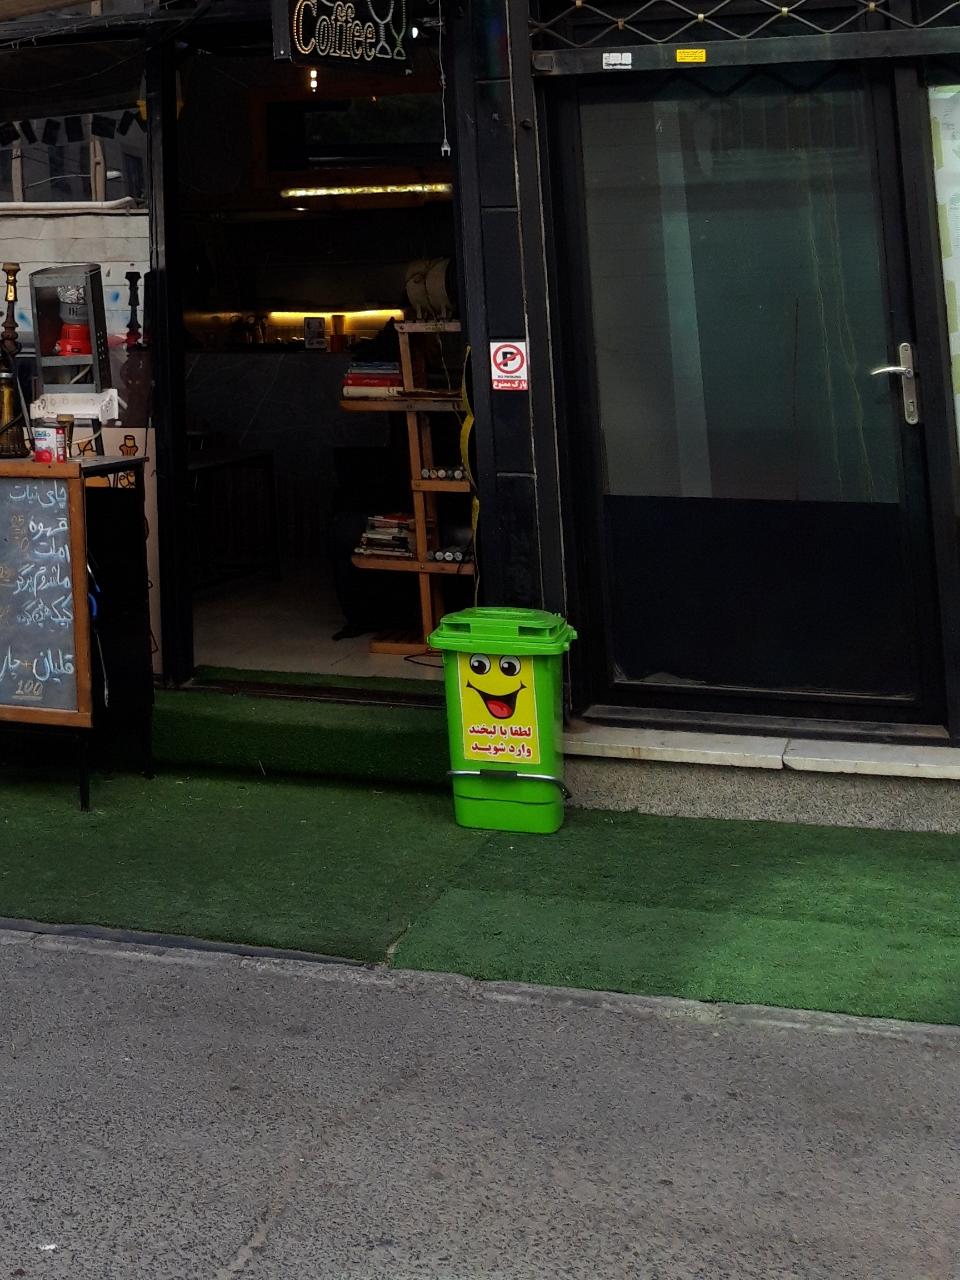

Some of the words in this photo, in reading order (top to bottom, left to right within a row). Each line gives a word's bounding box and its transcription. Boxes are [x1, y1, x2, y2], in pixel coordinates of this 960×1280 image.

[38, 480, 67, 509] چای
[469, 723, 497, 738] لبخند
[499, 725, 508, 738] با
[510, 725, 532, 738] لطفا
[471, 742, 506, 755] شوید
[508, 743, 532, 758] وارد
